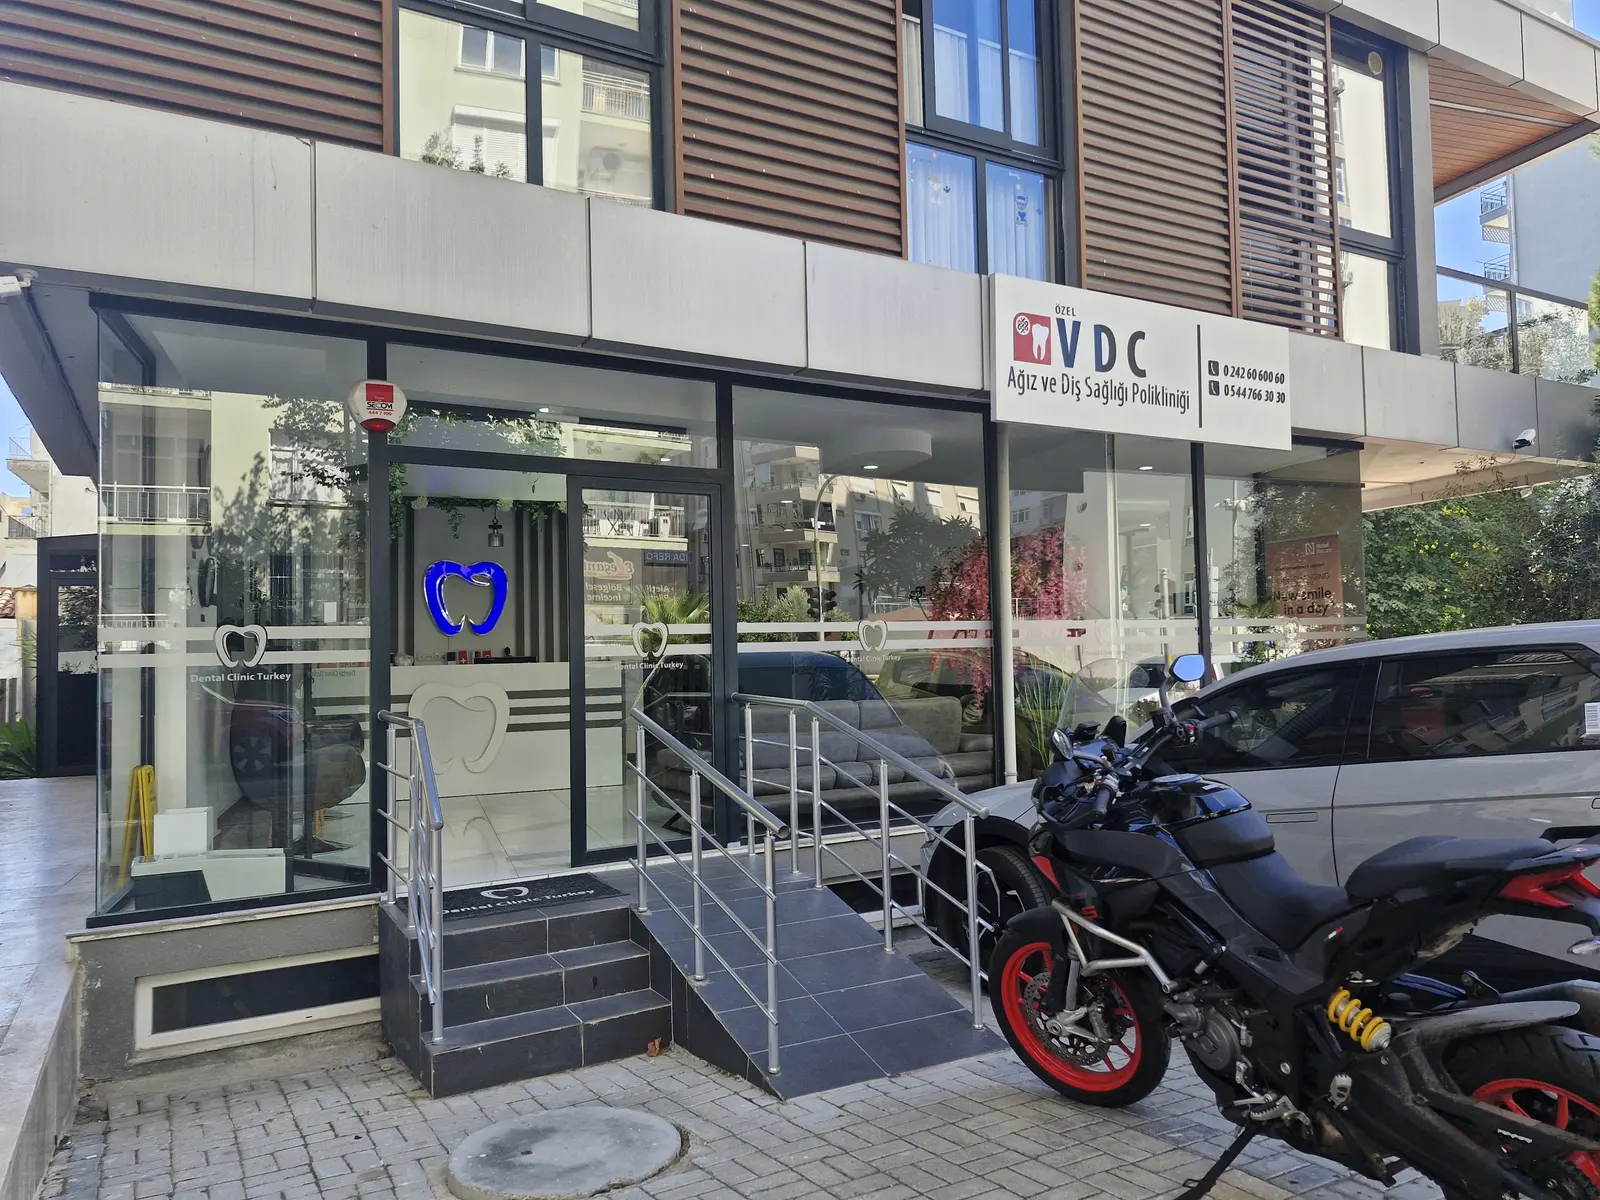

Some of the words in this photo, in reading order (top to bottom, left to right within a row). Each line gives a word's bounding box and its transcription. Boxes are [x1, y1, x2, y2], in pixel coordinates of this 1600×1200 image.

[1055, 303, 1076, 317] ÖZEL
[1007, 366, 1038, 396] Ağız
[1041, 376, 1057, 393] ve
[1061, 373, 1081, 402] Diş
[1085, 377, 1128, 407] Sağlığı
[1132, 382, 1190, 415] Polikliniği
[882, 654, 901, 662] Turkey
[660, 661, 684, 670] Turkey
[190, 674, 225, 682] Dental
[227, 672, 255, 682] Clinic
[256, 672, 292, 682] Turkey
[496, 898, 542, 907] Clinic
[544, 889, 595, 900] Turkey
